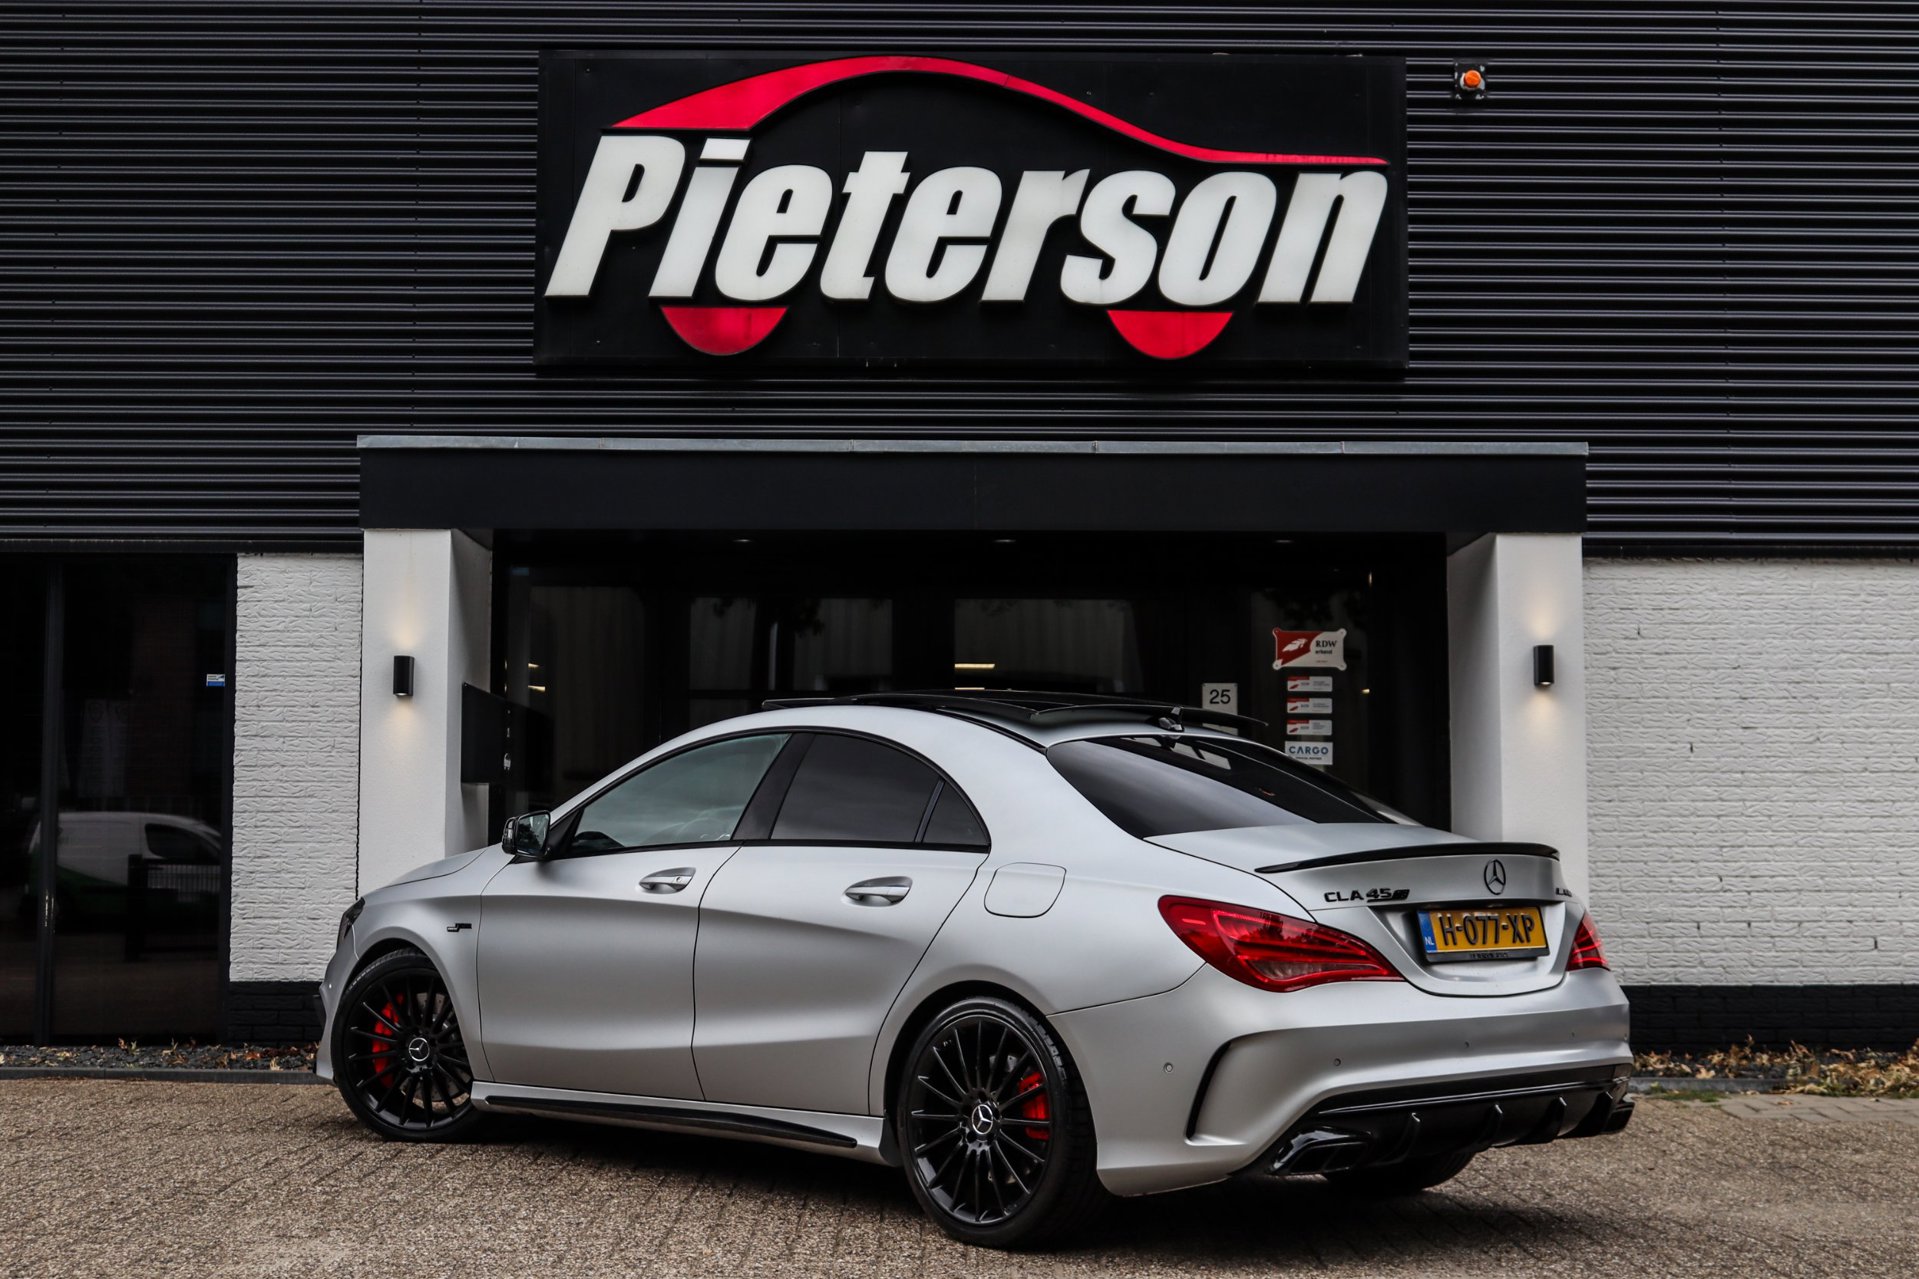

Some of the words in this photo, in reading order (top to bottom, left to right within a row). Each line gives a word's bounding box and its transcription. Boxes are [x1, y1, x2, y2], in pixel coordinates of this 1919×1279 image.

[544, 135, 1389, 306] Pieterson
[1315, 640, 1337, 648] RDW
[1209, 689, 1231, 705] 25
[1288, 746, 1329, 755] CARGO
[1324, 890, 1364, 902] CLA
[1438, 911, 1535, 946] H-077-XP
[1424, 936, 1435, 946] NL
